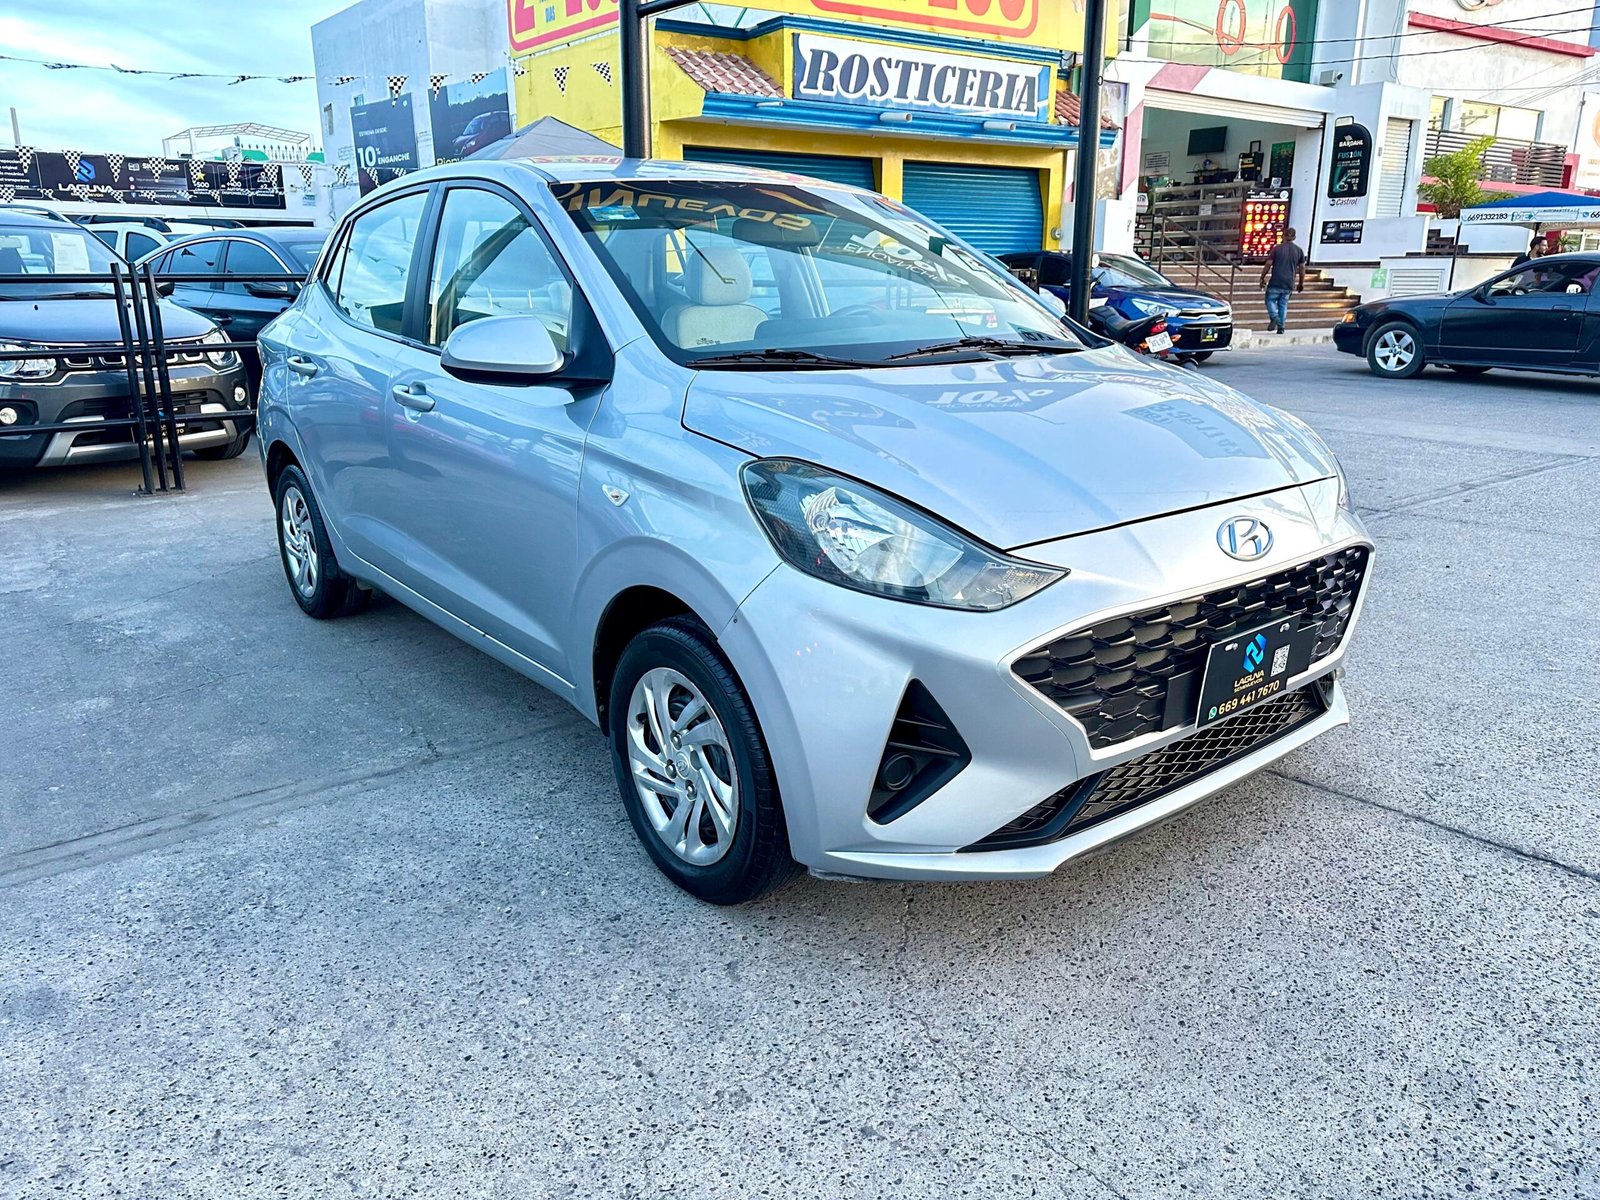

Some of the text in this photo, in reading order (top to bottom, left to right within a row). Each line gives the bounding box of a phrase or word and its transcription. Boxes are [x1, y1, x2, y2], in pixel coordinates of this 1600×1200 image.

[802, 48, 1038, 113] ROSTICERIA
[1338, 139, 1364, 148] BARDAHL
[377, 152, 410, 165] ENGANCHE
[1336, 198, 1358, 206] Castrol
[1467, 212, 1508, 221] 6691332183
[1234, 669, 1265, 688] LAGUNA
[1218, 680, 1280, 715] 669 441 7670
